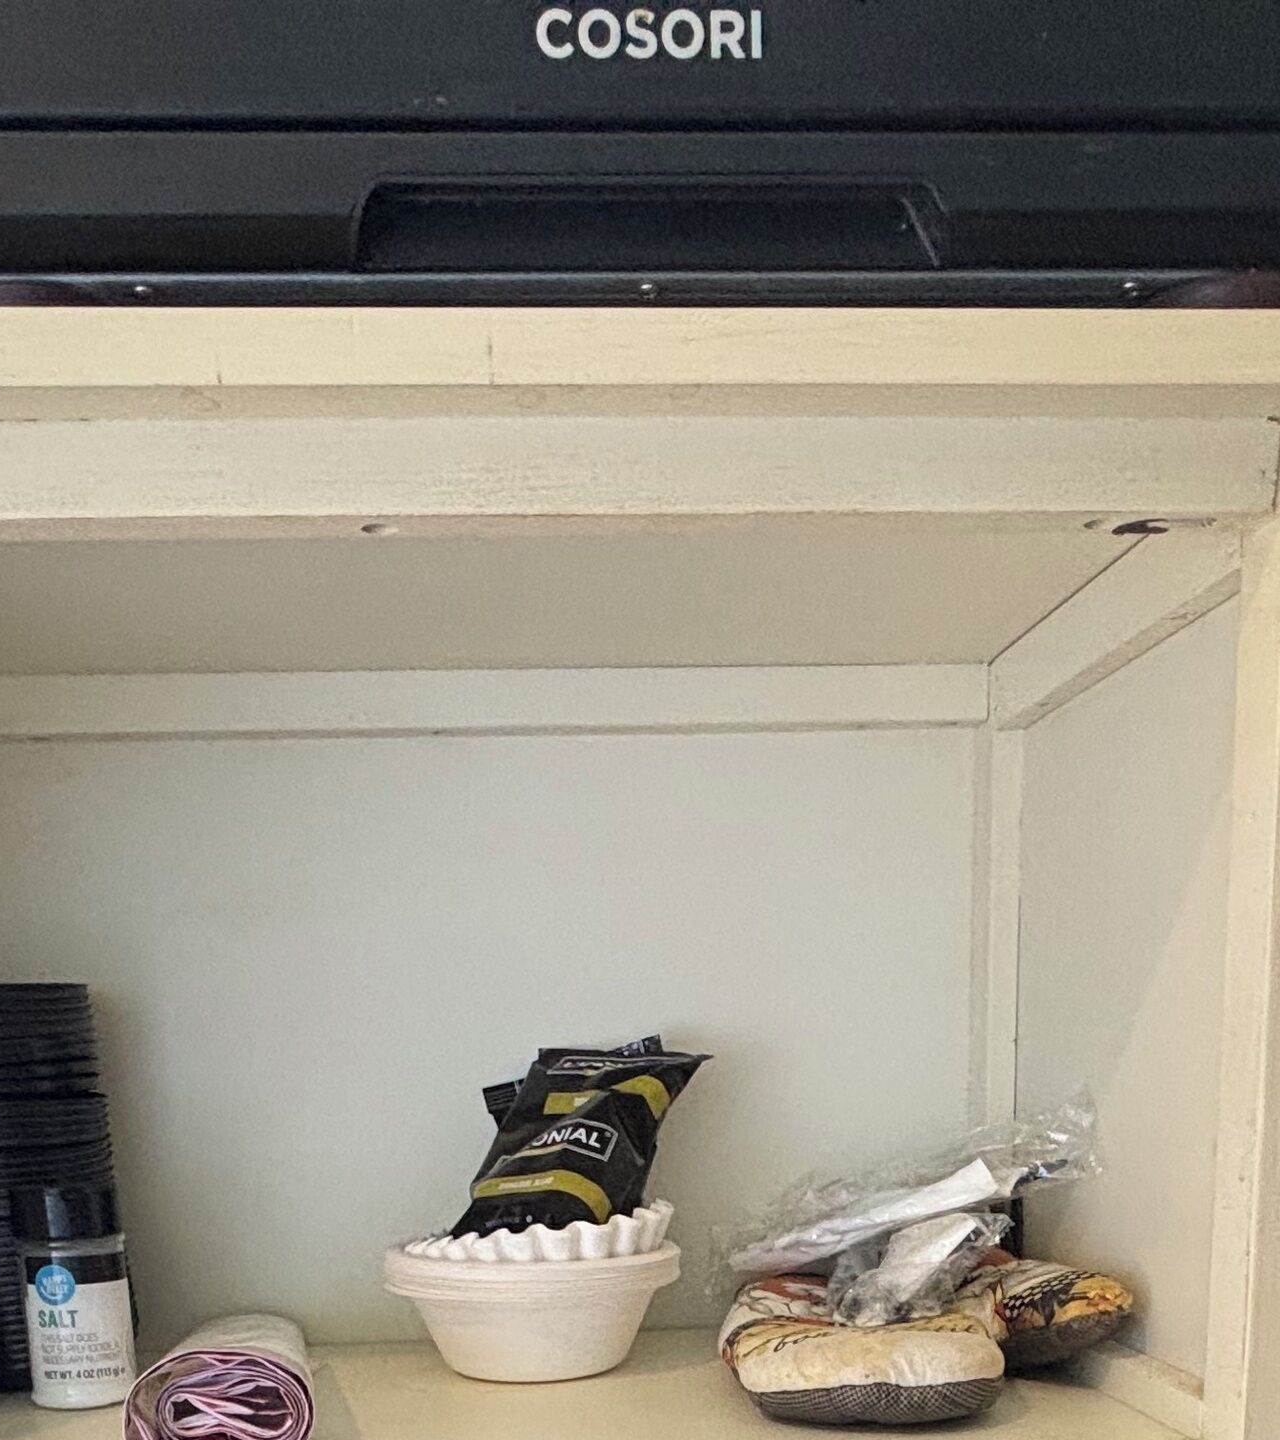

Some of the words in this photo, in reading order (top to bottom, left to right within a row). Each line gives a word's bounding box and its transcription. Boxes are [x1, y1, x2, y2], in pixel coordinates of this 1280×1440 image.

[535, 8, 763, 60] COSORI
[38, 1309, 78, 1328] SALT
[83, 1369, 95, 1379] OZ
